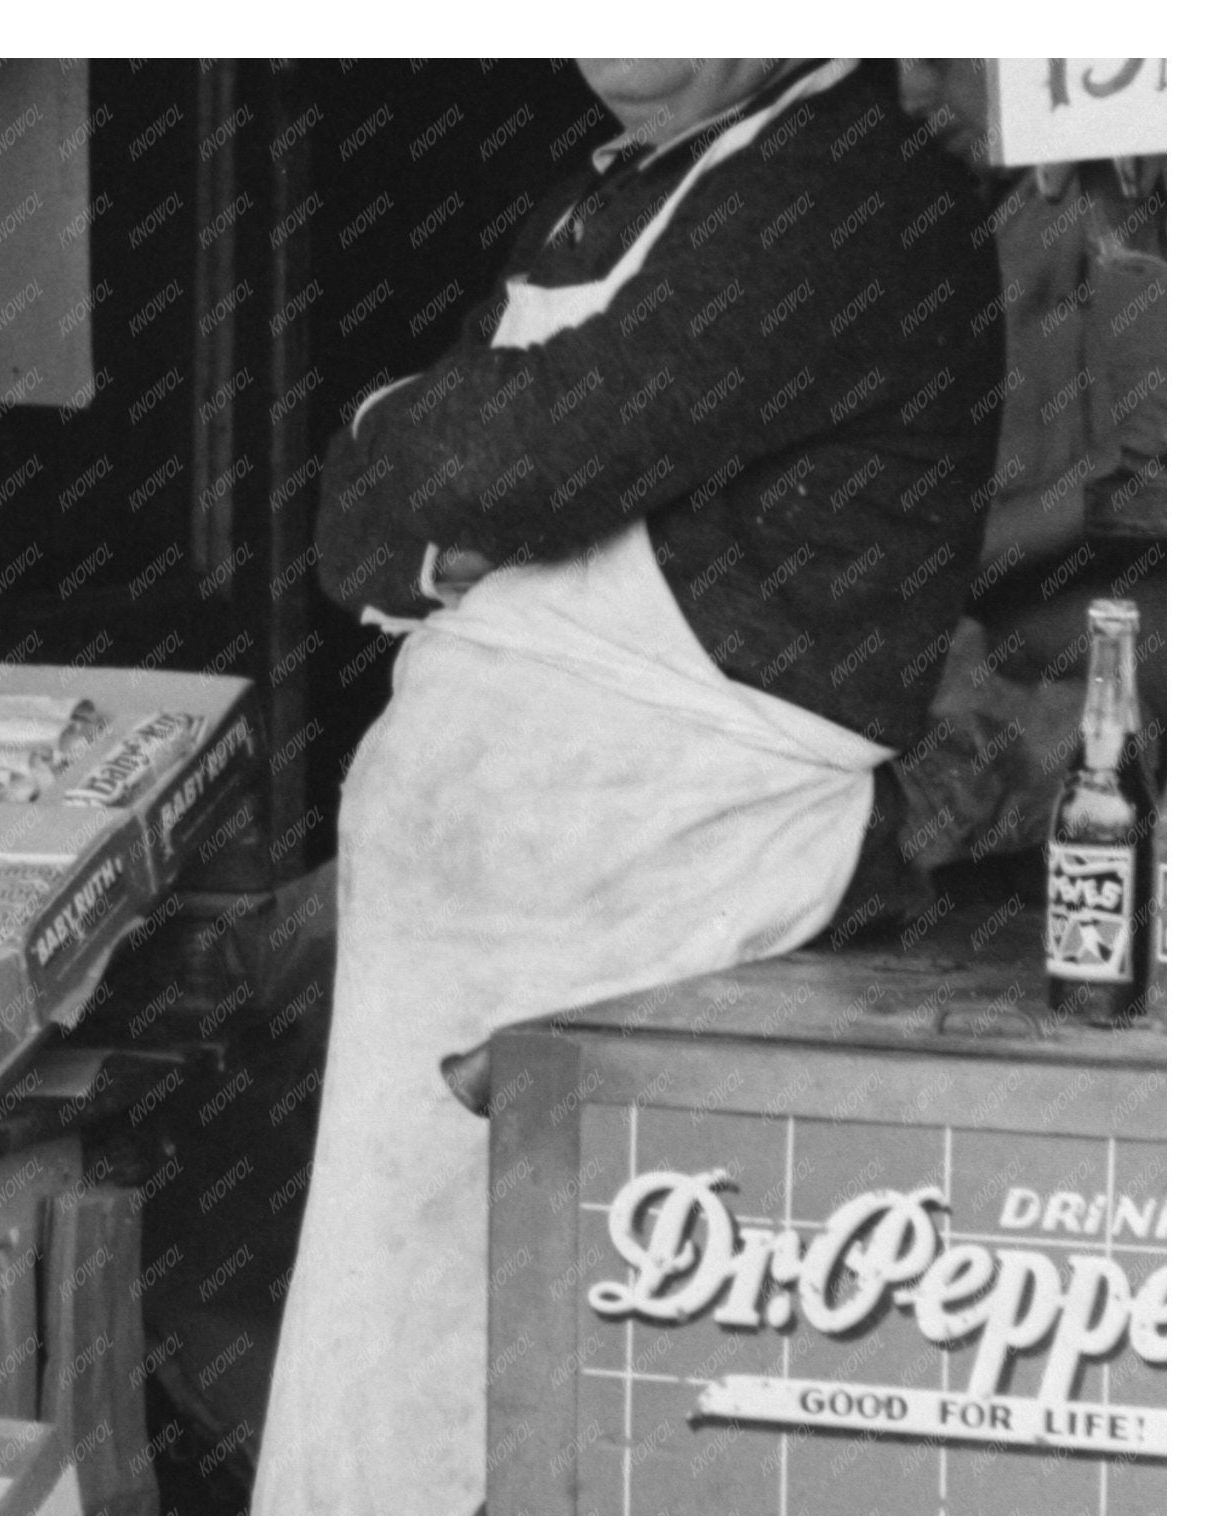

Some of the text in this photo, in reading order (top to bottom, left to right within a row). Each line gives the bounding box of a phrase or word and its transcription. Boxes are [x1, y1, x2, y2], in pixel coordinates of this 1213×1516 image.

[798, 1388, 1147, 1443] GOOD FOR LIFE!
